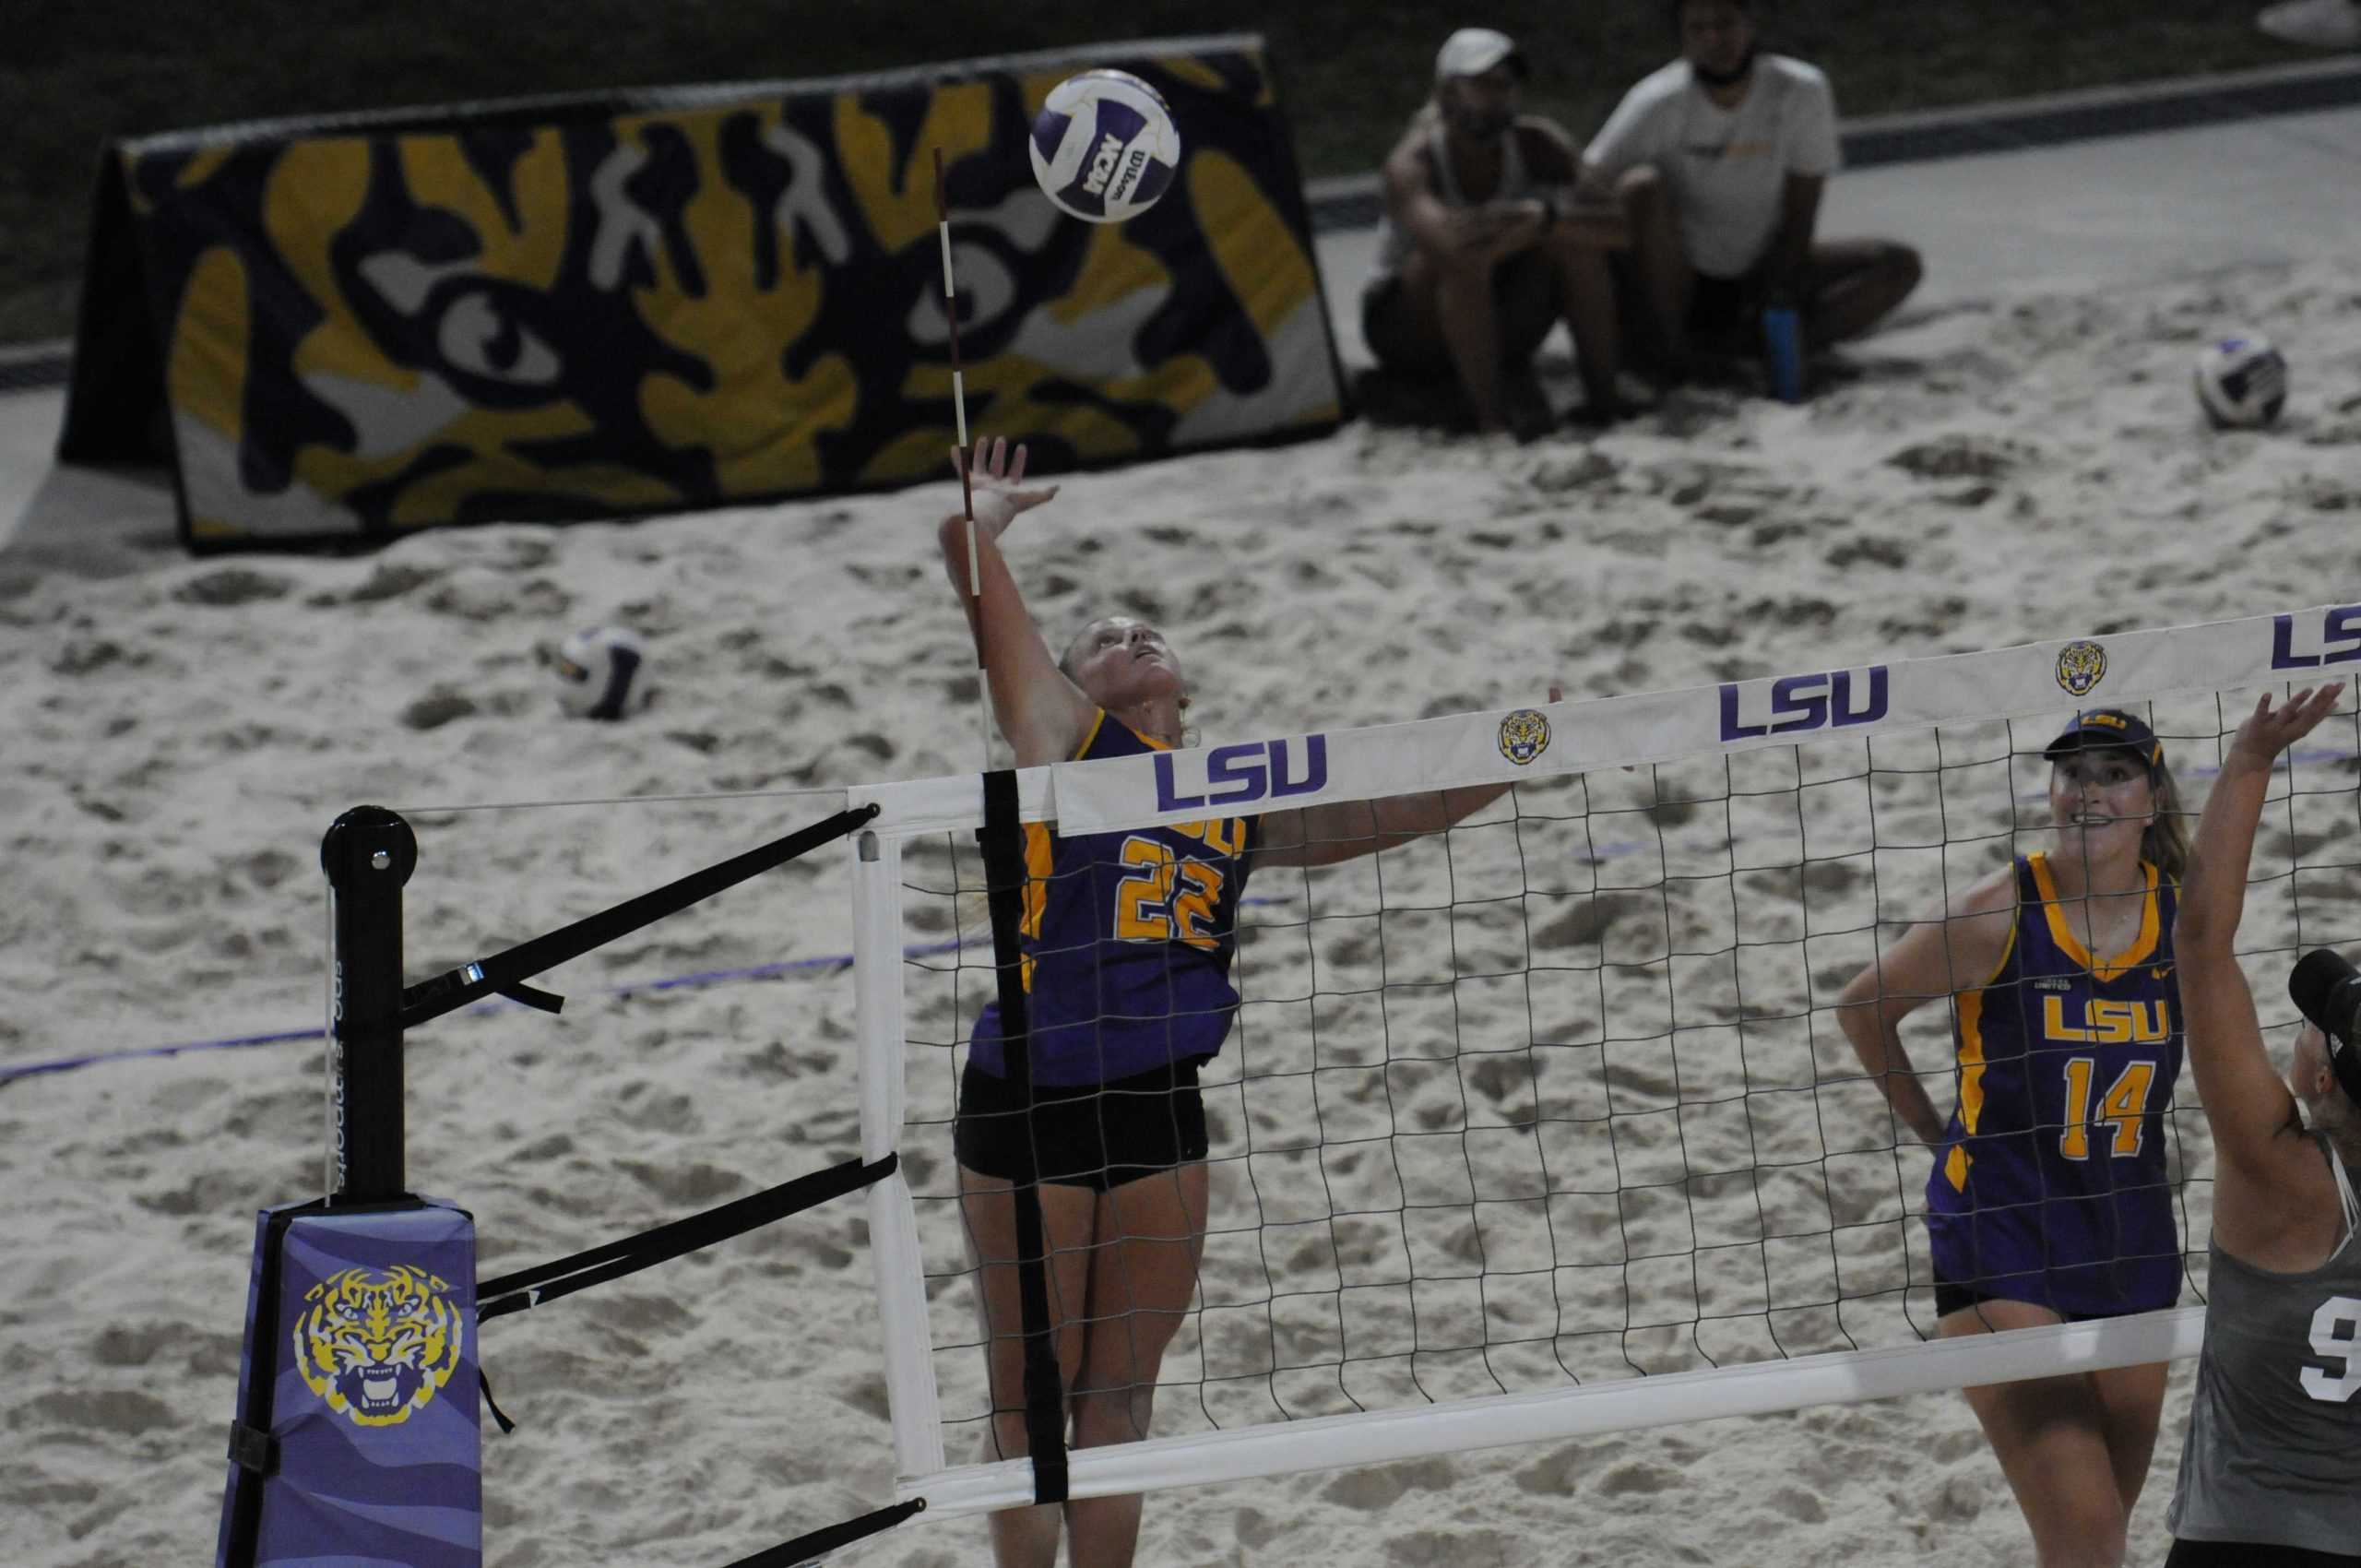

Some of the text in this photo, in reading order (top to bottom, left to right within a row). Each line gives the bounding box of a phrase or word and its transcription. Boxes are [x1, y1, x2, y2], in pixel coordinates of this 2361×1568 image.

[1113, 150, 1145, 200] Wilson
[1719, 665, 1888, 742] LSU
[1154, 734, 1327, 812] LSU
[1113, 835, 1223, 951] 22
[2044, 995, 2171, 1045] LSU
[2059, 1058, 2156, 1160] 14
[2300, 1296, 2361, 1402] 9
